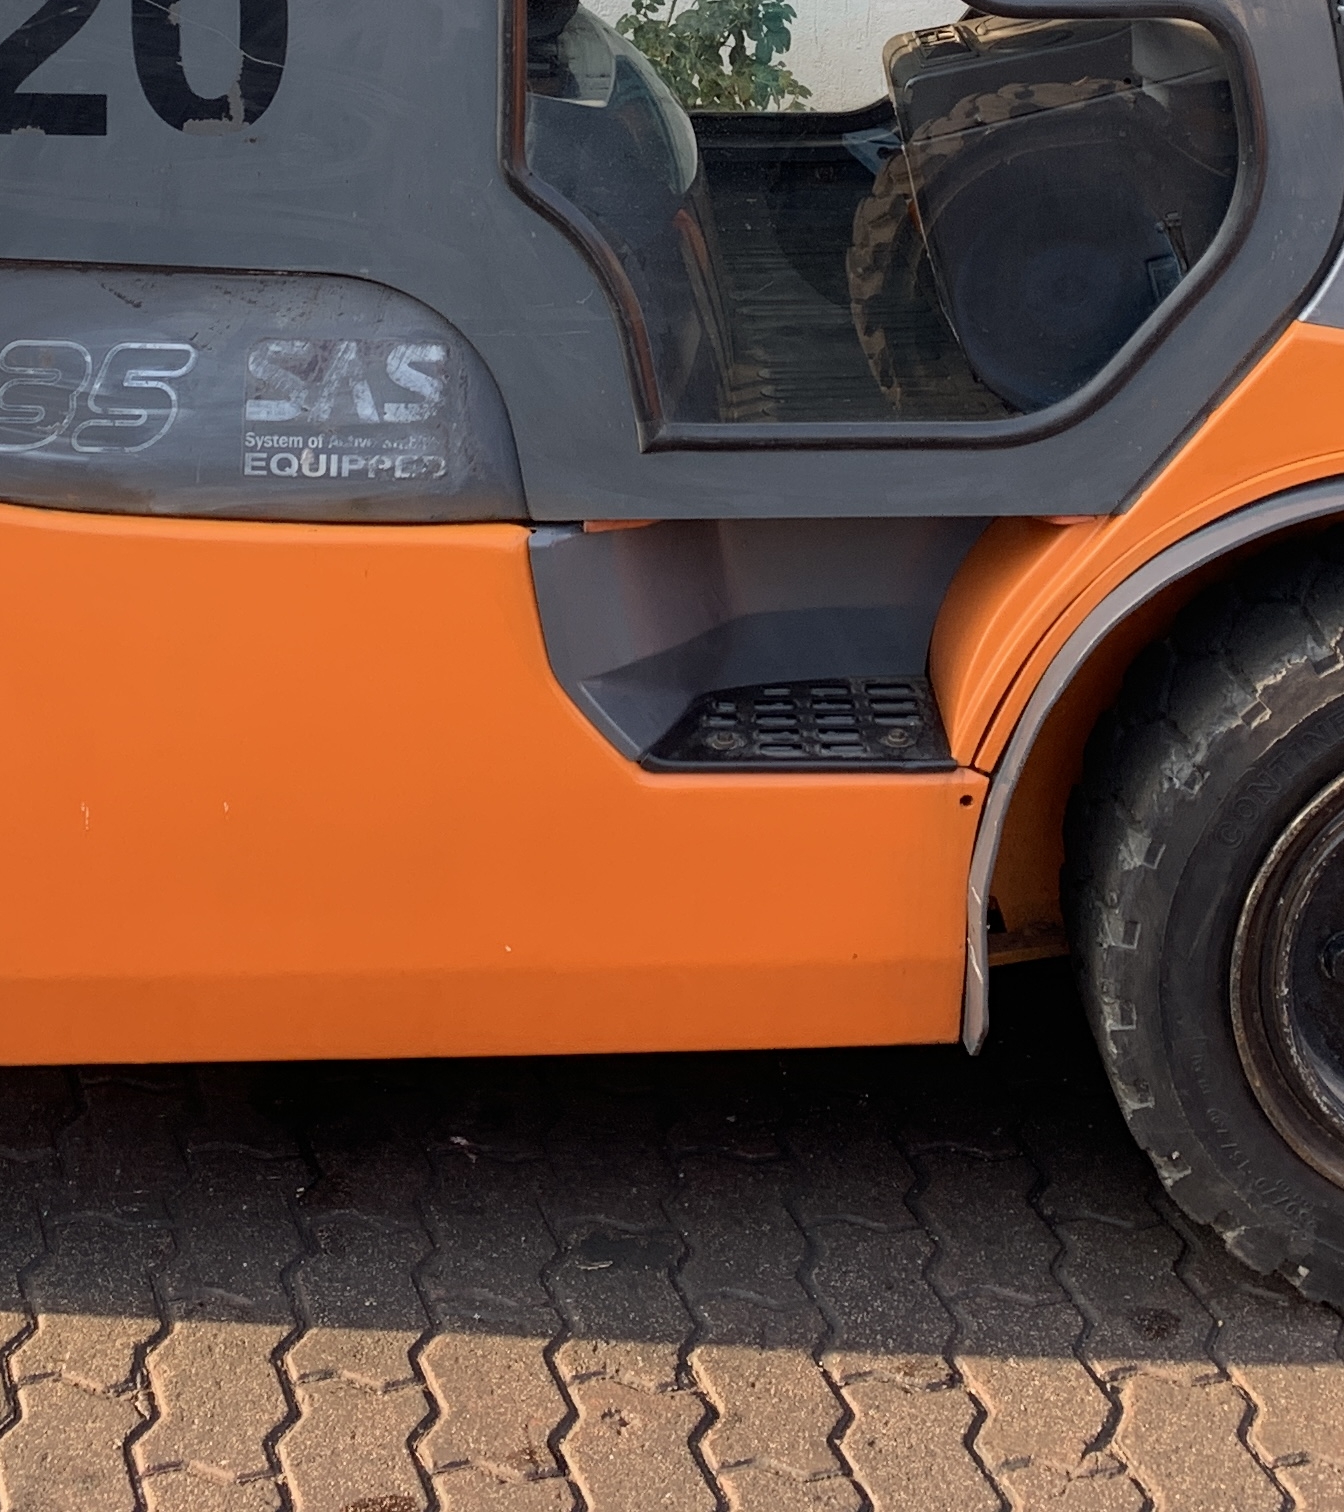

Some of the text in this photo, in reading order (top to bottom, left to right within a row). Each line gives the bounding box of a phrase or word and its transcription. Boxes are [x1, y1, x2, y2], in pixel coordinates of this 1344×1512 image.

[245, 340, 446, 423] SAS
[244, 431, 303, 451] System
[307, 433, 325, 449] of
